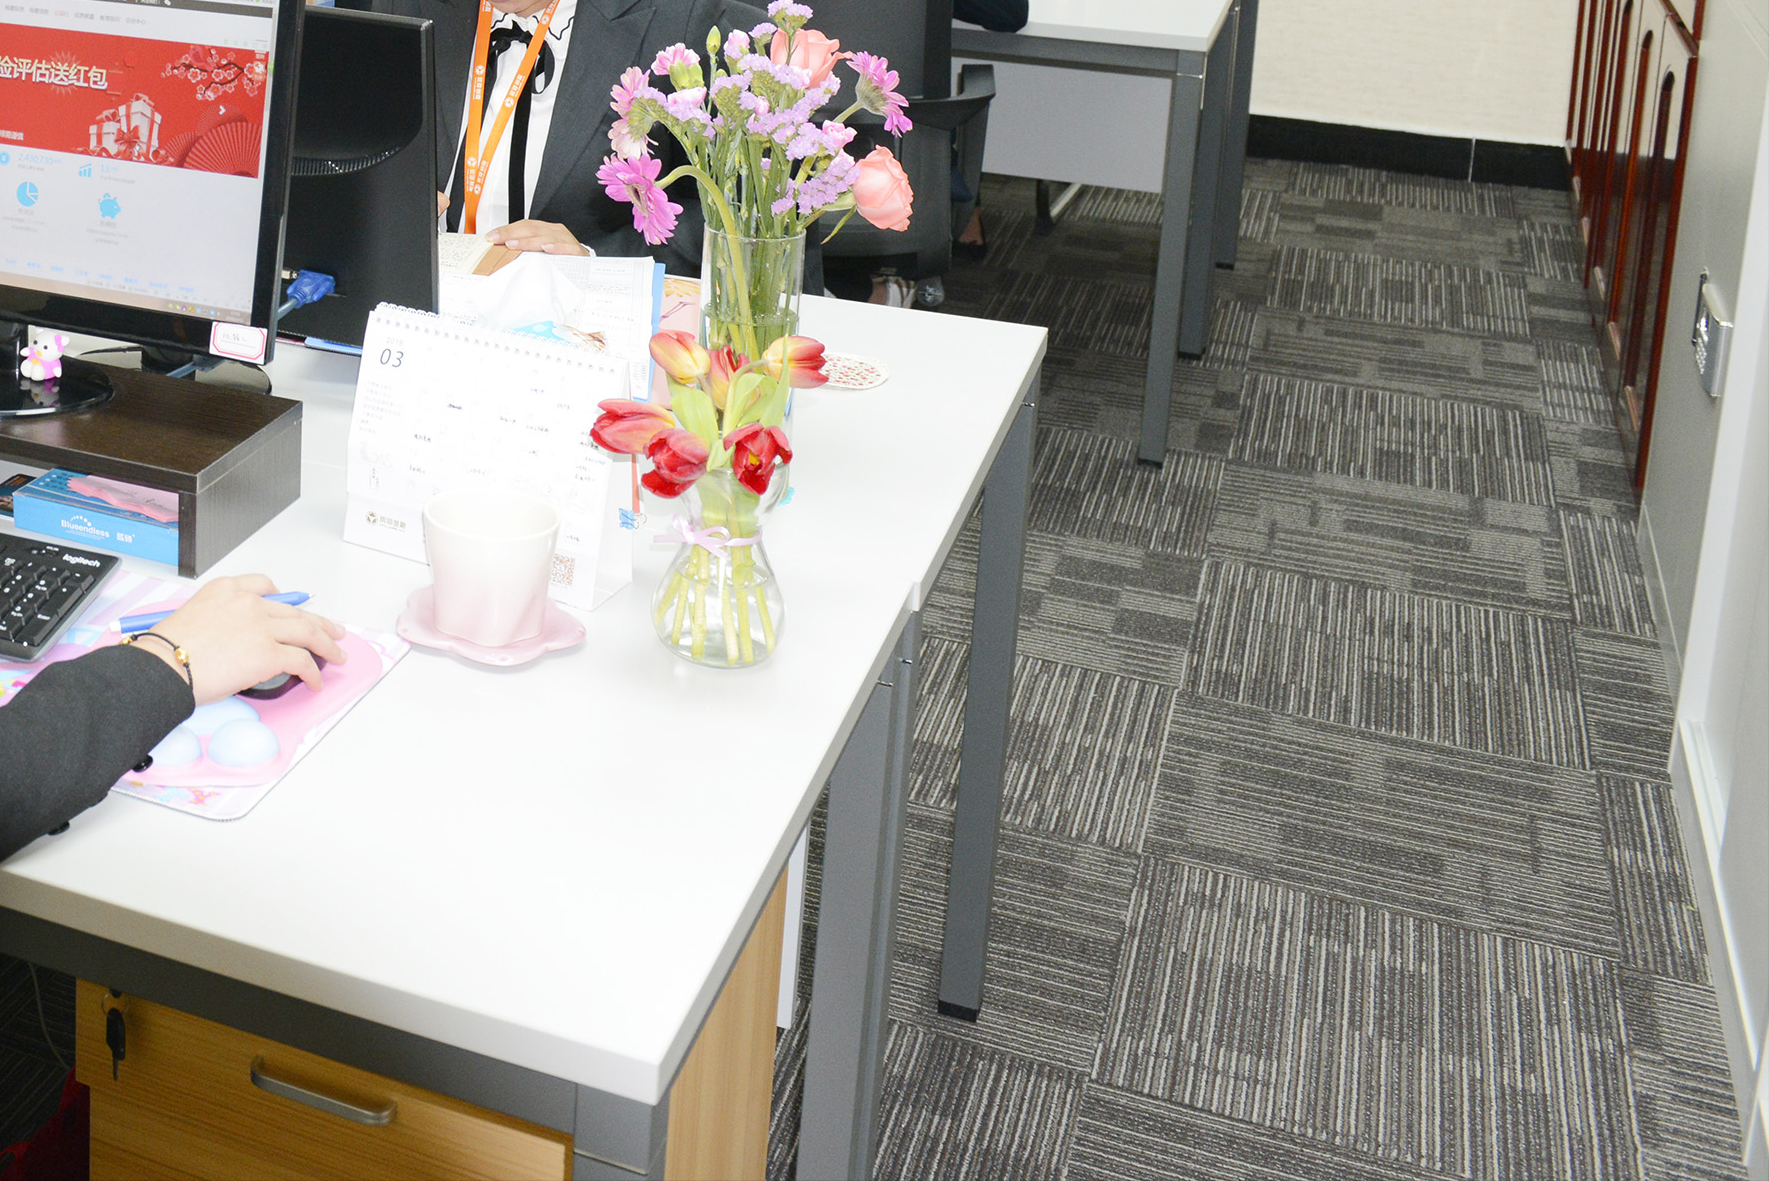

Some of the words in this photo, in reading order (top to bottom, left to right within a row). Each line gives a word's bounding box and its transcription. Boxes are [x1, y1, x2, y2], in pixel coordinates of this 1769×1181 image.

[380, 348, 404, 368] 03
[61, 519, 110, 538] Blueendless
[62, 554, 101, 568] logitech
